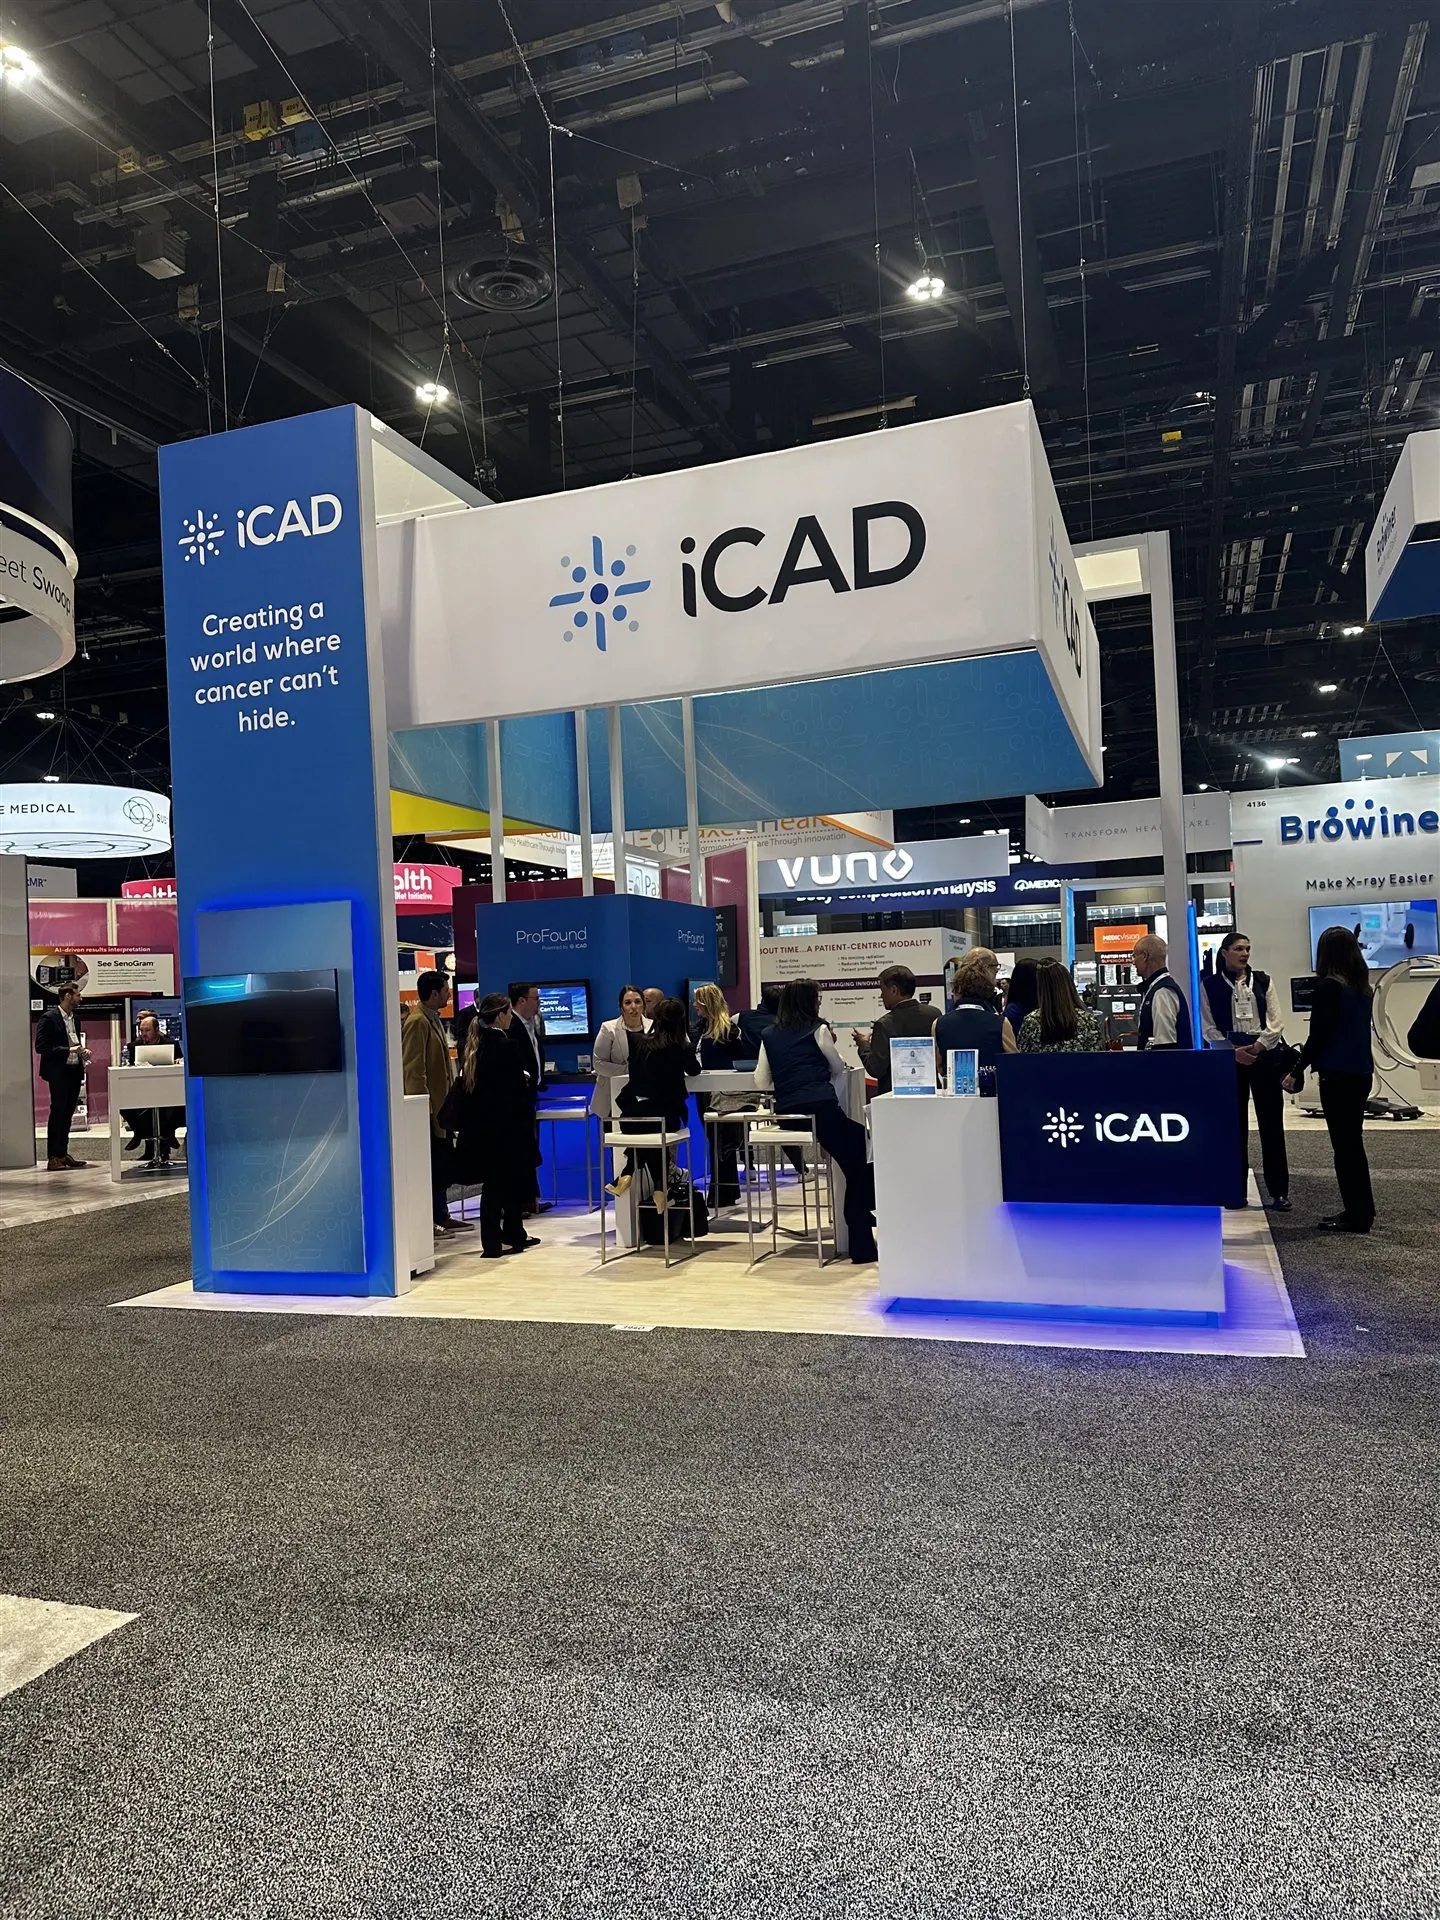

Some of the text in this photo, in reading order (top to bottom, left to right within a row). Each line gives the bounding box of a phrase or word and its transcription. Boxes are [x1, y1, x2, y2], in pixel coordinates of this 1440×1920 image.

[236, 493, 343, 548] iCAD
[681, 500, 927, 617] iCAD
[33, 566, 71, 617] Swoop
[202, 601, 324, 636] Creating a
[190, 634, 341, 672] world where
[194, 664, 339, 705] cancer can't
[238, 707, 296, 733] hide.
[10, 804, 75, 814] MEDICAL
[1064, 827, 1128, 839] TRANSFORM
[1306, 873, 1434, 890] Make X-ray Easier
[516, 926, 587, 944] ProFound
[678, 930, 705, 945] ProFound
[814, 941, 887, 952] PATIENT-CENTRIC
[889, 939, 932, 949] MODALITY
[108, 946, 151, 954] interpretation
[97, 960, 112, 968] See
[1094, 1113, 1190, 1143] iCAD
